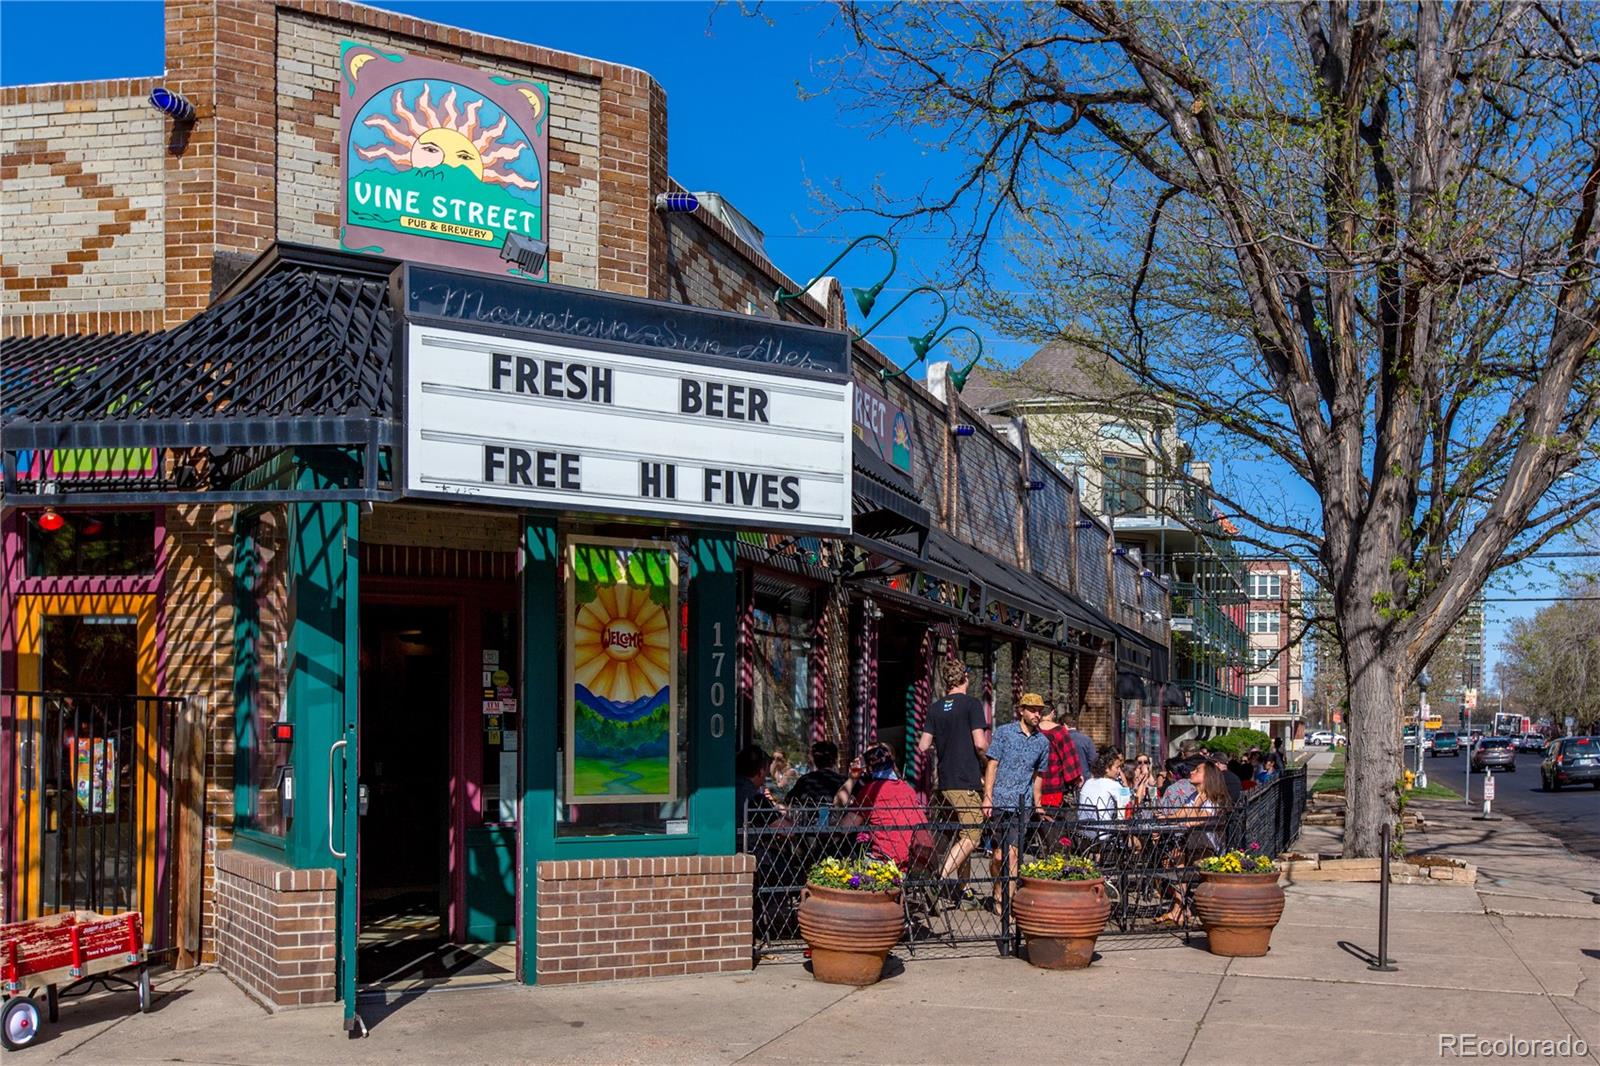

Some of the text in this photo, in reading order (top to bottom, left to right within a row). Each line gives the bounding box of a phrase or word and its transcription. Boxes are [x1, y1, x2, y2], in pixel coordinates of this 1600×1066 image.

[354, 181, 535, 233] VINE STREET
[407, 217, 487, 239] PUB & BREWERY
[430, 283, 636, 339] Mountain
[491, 352, 769, 423] FRESH BEER
[855, 385, 887, 438] REET
[484, 445, 800, 510] FREE HI FIVES
[710, 622, 725, 738] 1700
